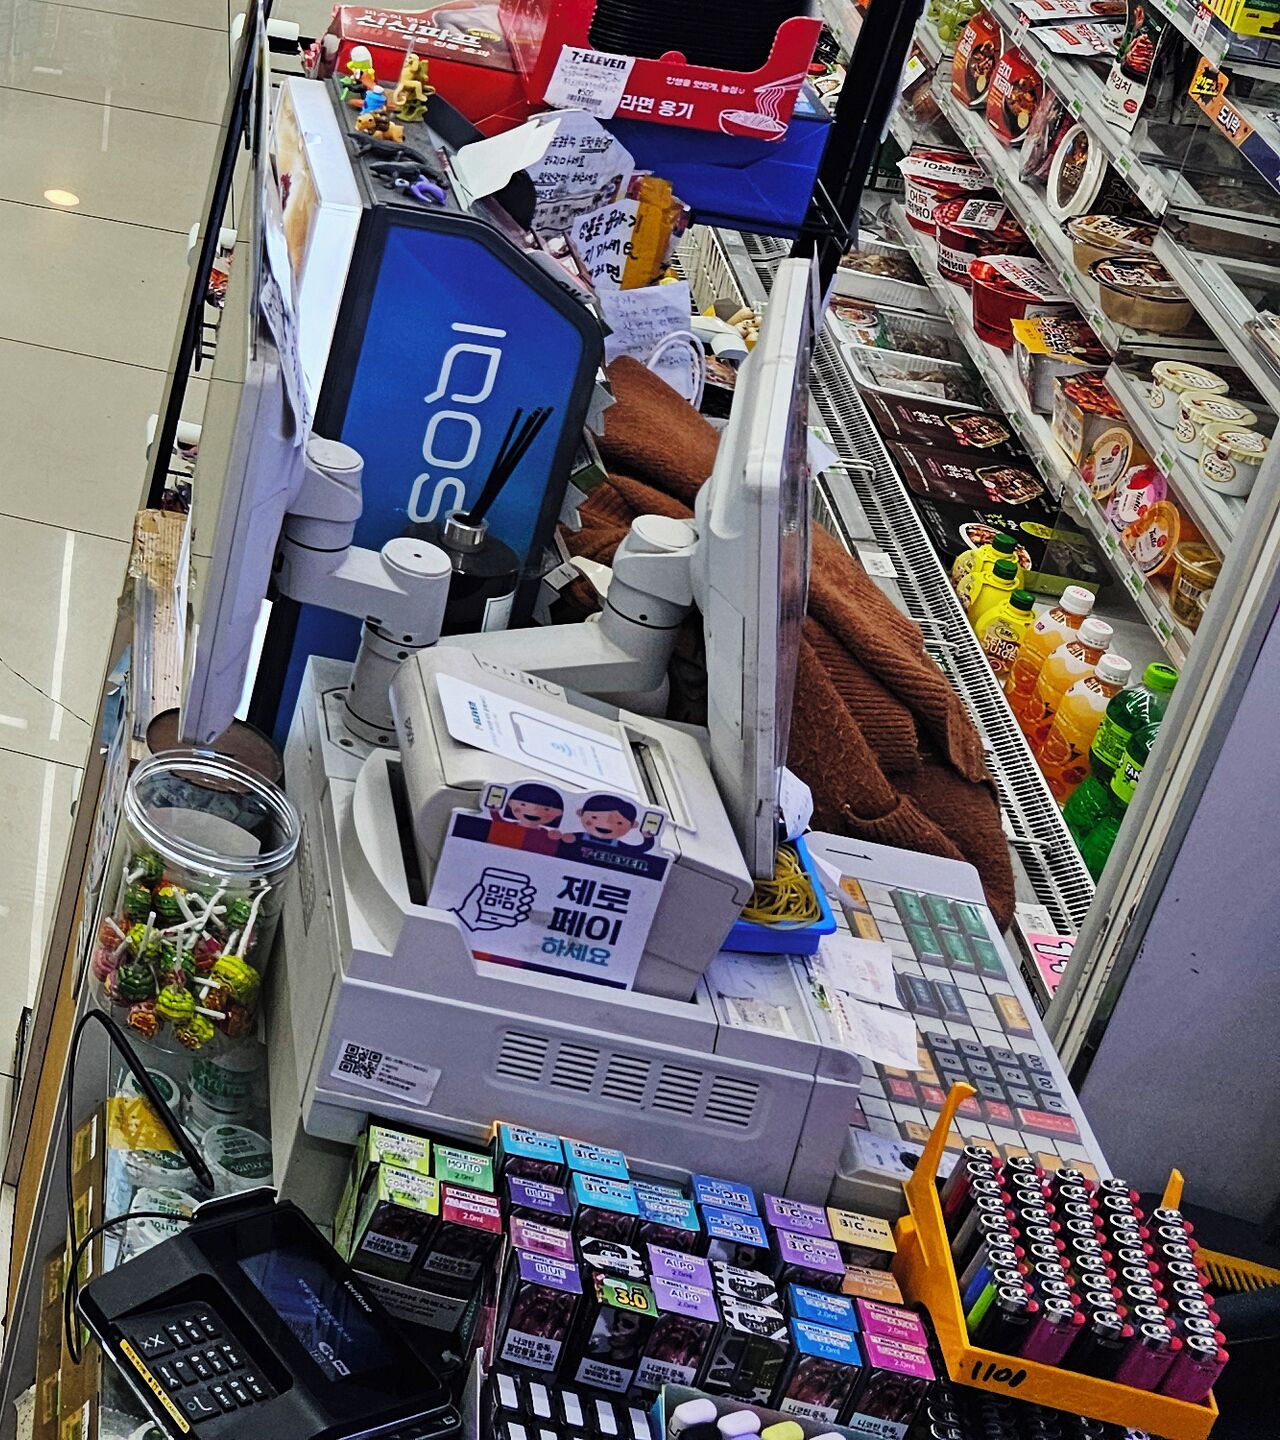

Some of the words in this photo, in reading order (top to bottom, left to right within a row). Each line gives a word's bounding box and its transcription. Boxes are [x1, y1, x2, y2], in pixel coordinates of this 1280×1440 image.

[621, 94, 654, 114] 라면
[658, 98, 694, 120] 용기
[408, 321, 507, 524] IQOS
[557, 873, 631, 915] 제로
[547, 903, 623, 947] 페이
[541, 934, 613, 968] 하세요
[616, 1287, 647, 1309] 3.0
